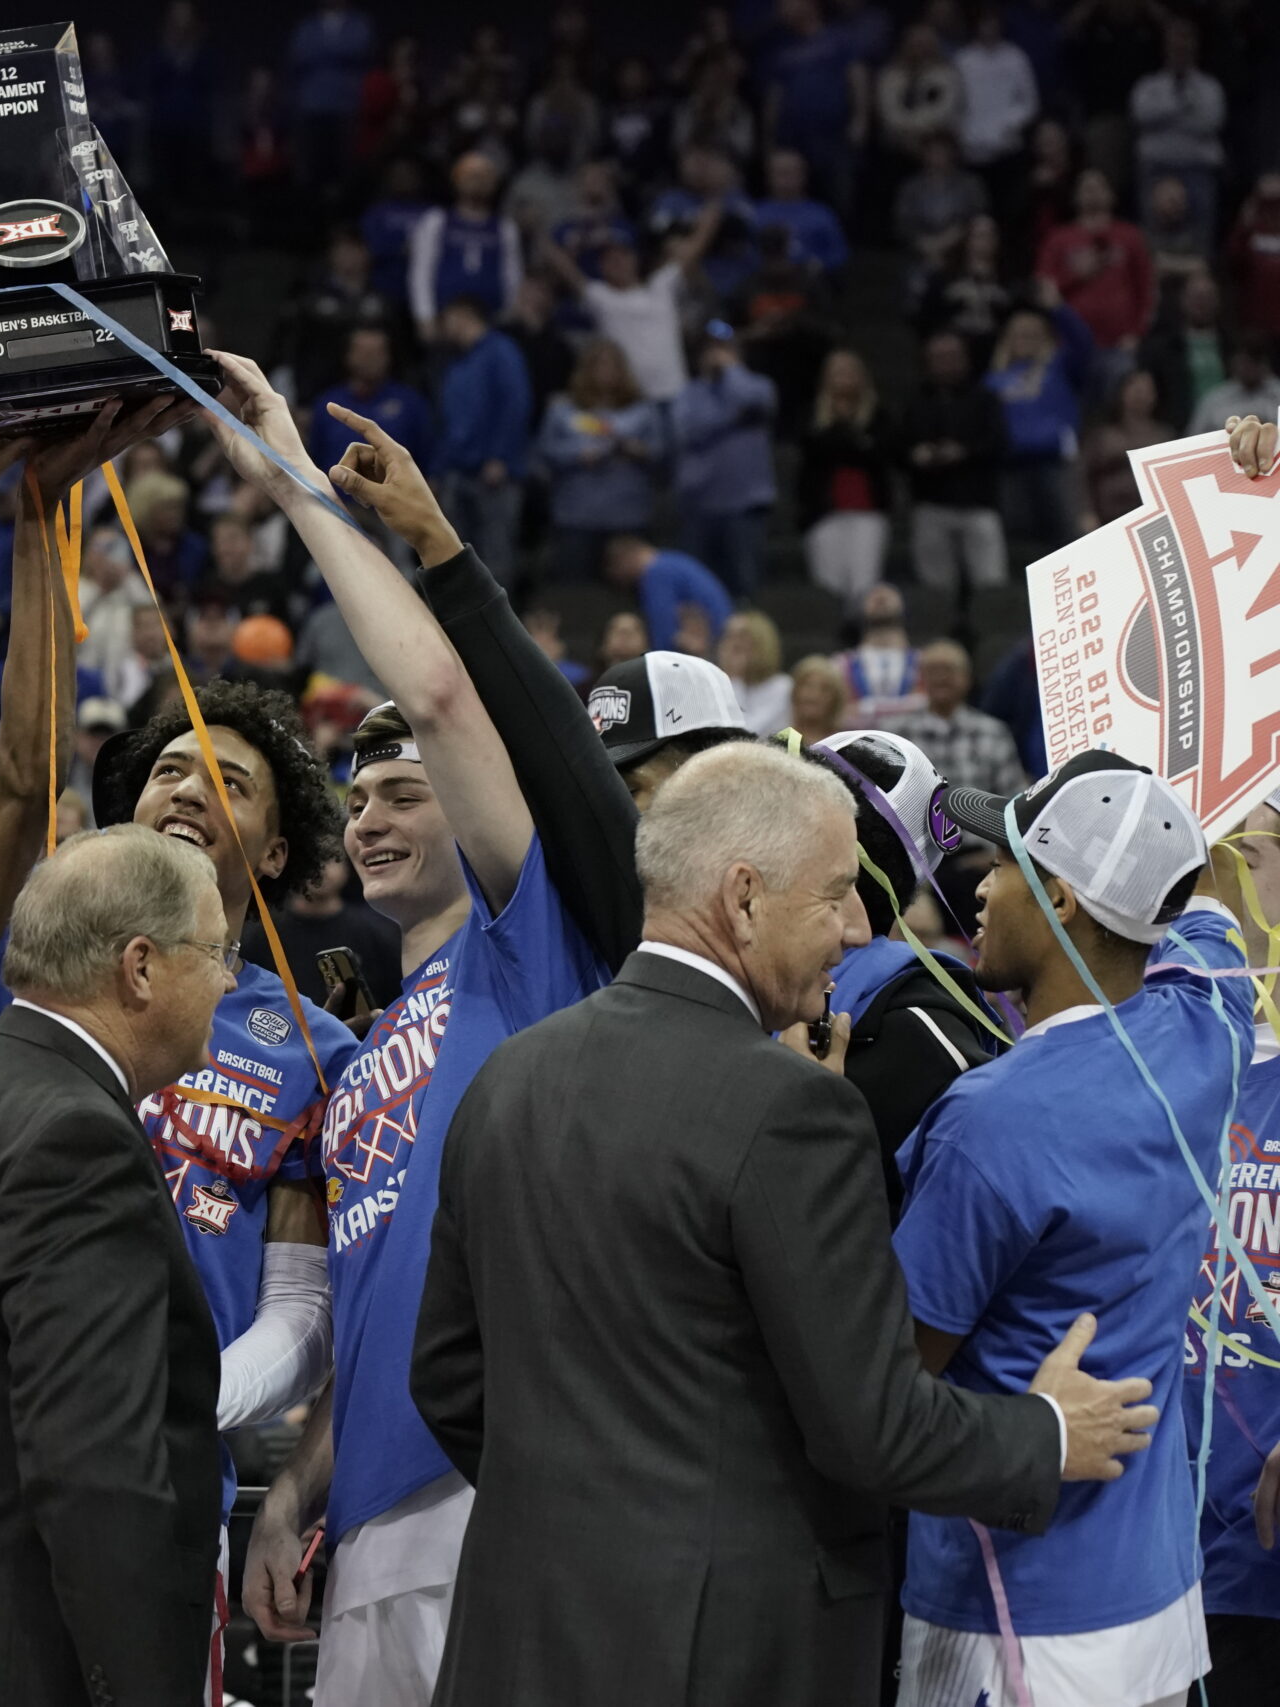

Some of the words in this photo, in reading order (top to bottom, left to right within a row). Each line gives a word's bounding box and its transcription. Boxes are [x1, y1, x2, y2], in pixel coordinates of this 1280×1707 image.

[0, 67, 18, 81] 12
[30, 311, 93, 328] BASKETBA
[95, 328, 115, 342] 22
[1052, 565, 1077, 646] MEN'S
[1076, 570, 1104, 660] 2022
[1152, 535, 1194, 751] CHAMPIONSHIP
[1038, 628, 1070, 766] CHAMPION
[1062, 650, 1089, 751] BASKET
[1087, 670, 1113, 736] BIG
[177, 1069, 277, 1115] ERENCE
[217, 1049, 283, 1086] BASKETBALL
